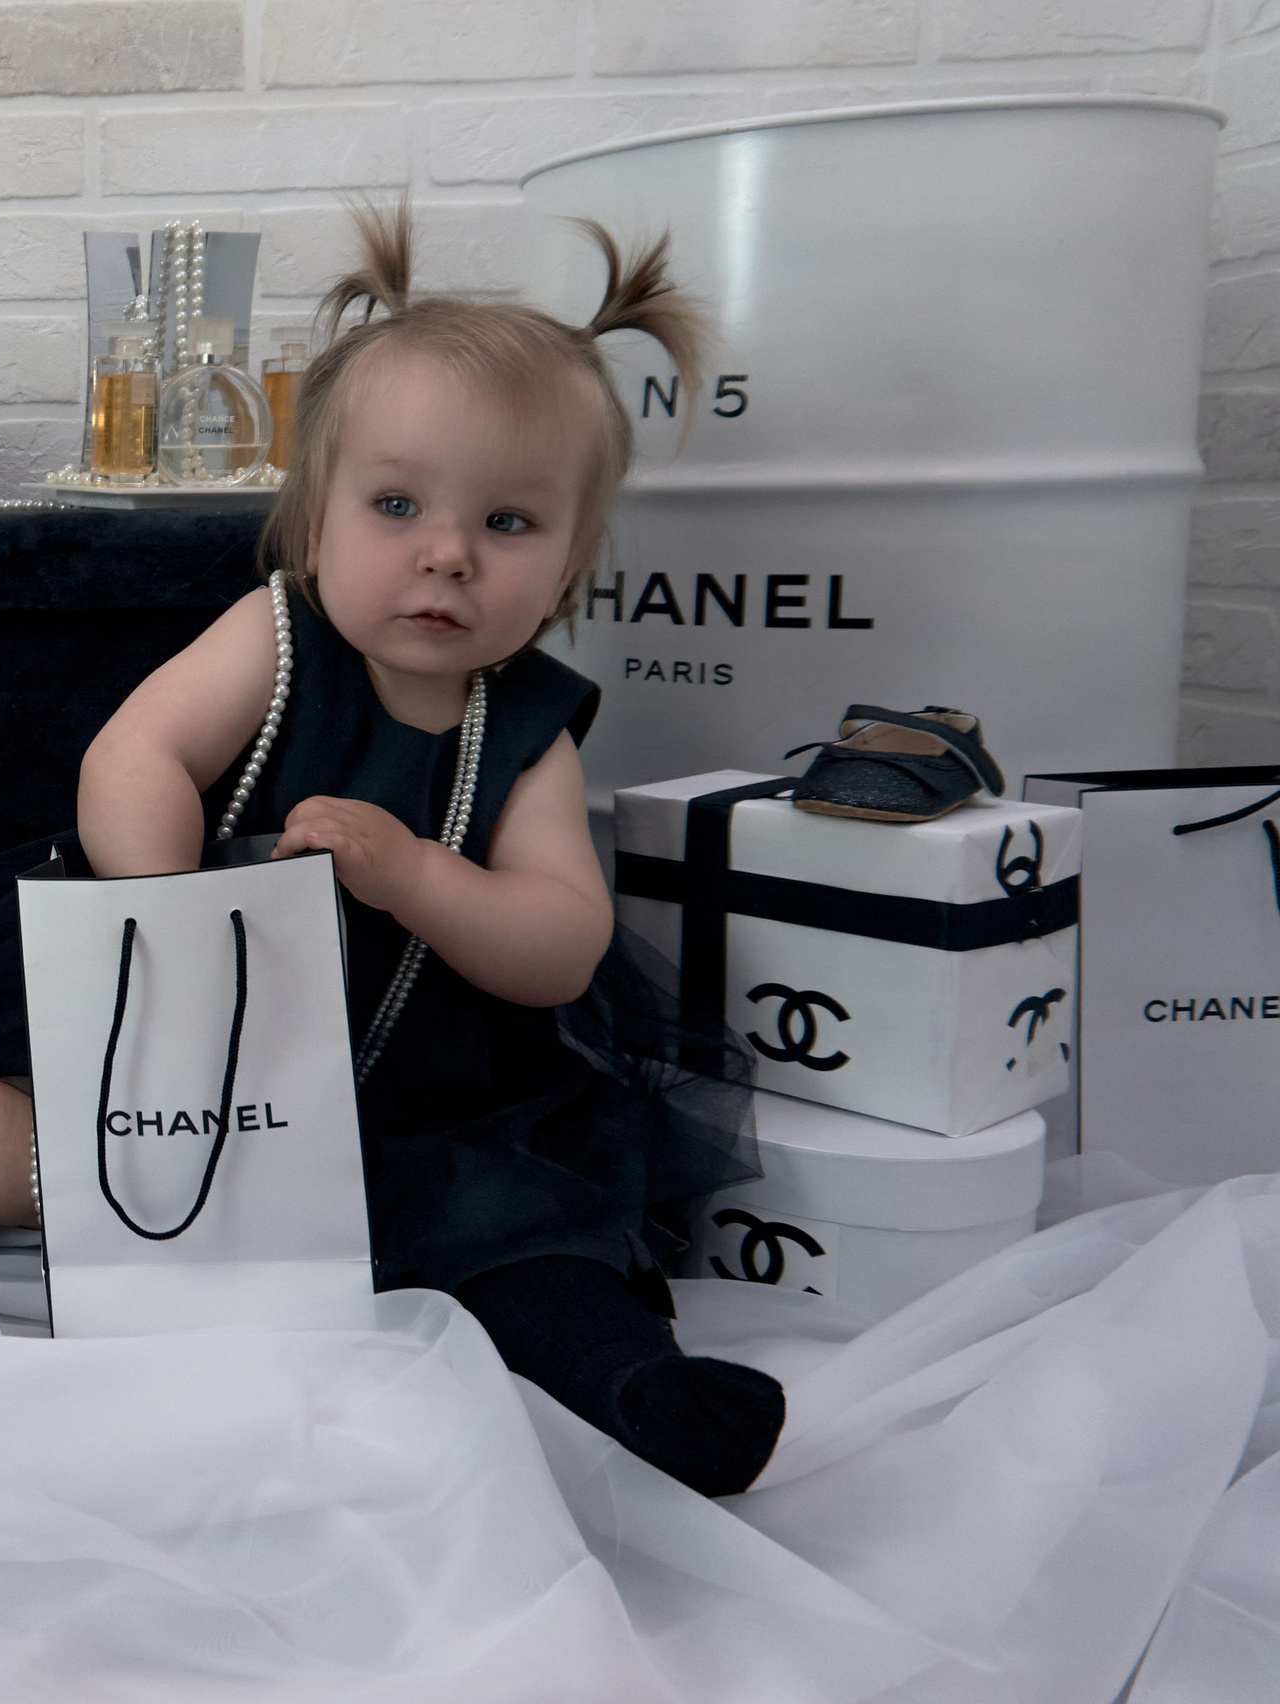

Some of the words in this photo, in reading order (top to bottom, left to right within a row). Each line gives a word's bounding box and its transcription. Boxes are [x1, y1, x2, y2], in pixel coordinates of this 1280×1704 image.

[198, 426, 234, 434] CHANEL
[199, 415, 235, 423] CHANCE
[586, 570, 875, 630] HANEL
[624, 657, 734, 686] PARIS
[1143, 995, 1280, 1023] CHANE
[105, 1102, 289, 1137] CHANEL
